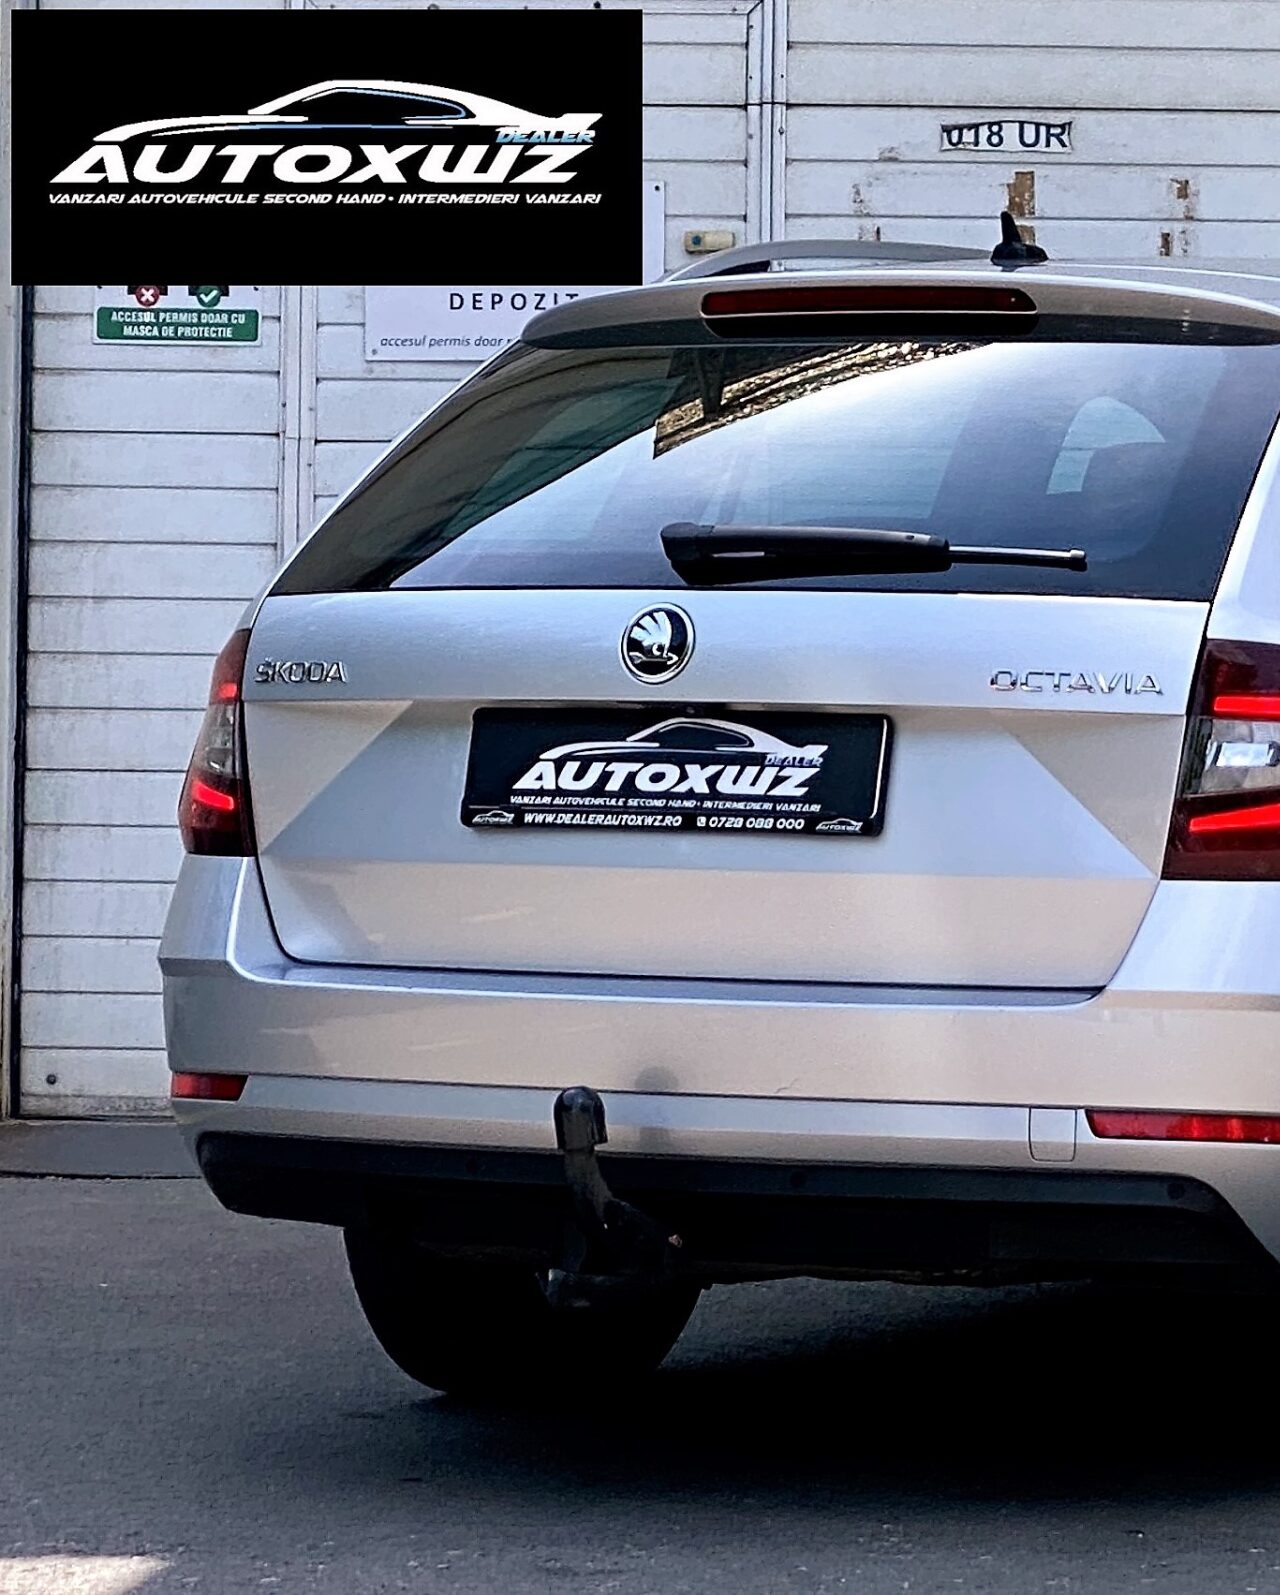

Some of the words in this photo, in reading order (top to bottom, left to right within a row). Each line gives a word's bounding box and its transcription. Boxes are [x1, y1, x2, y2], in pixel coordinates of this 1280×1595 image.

[1019, 121, 1068, 148] UR
[111, 311, 156, 322] ACCESUL
[159, 312, 198, 323] PERMIS
[201, 313, 228, 324] DOAR
[231, 313, 246, 324] CU
[123, 325, 159, 336] MASCA
[161, 325, 175, 336] DE
[177, 326, 233, 337] PROTECTIE
[380, 335, 427, 347] accesul
[428, 336, 471, 349] permis
[474, 336, 503, 347] doar
[989, 670, 1163, 695] OCTAVIA
[765, 754, 824, 767] DEALER
[512, 760, 821, 797] AUTOXWZ
[510, 795, 551, 805] VANZARI
[553, 796, 626, 807] AUTOVEHICULE
[627, 798, 666, 808] SECOND
[668, 799, 696, 809] HAND
[702, 801, 774, 811] INTERMEDIERI
[776, 803, 822, 813] VANZARI
[523, 813, 683, 827] WWW.DEALERAUTOXWZ.RO
[776, 818, 806, 830] 000
